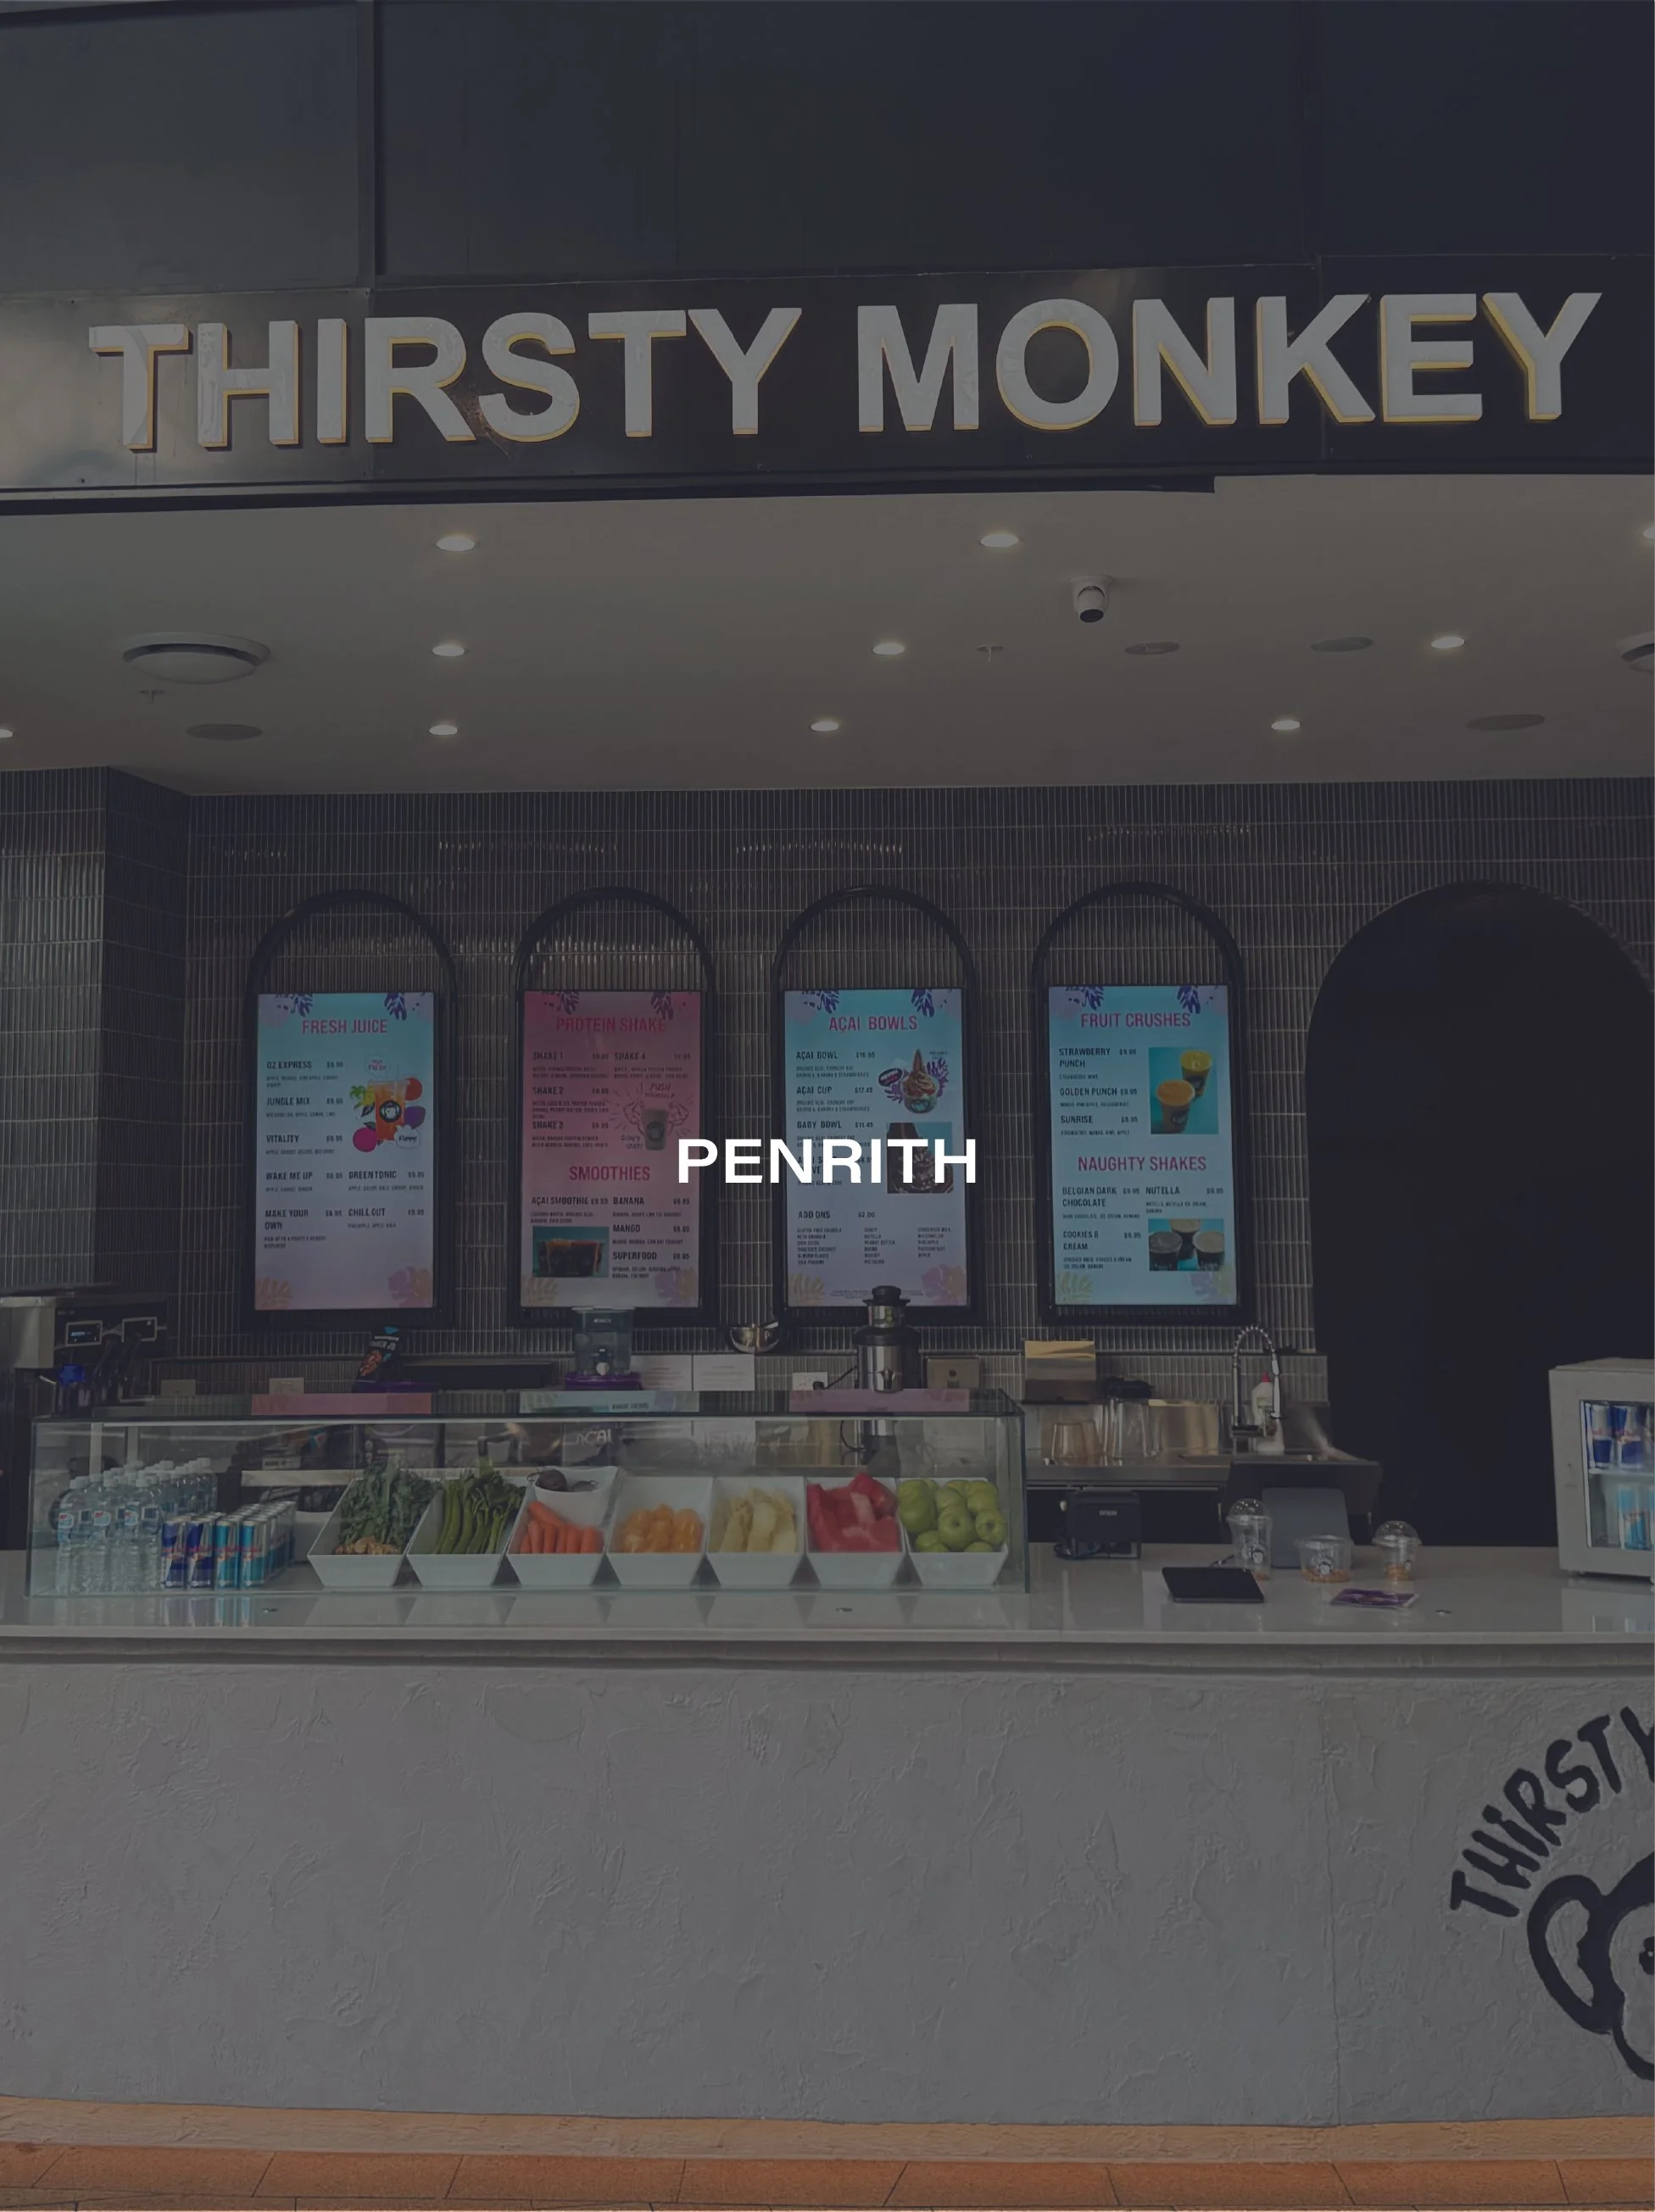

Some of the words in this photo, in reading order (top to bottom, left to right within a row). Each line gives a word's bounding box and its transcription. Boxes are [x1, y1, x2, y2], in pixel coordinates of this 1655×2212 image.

[88, 306, 802, 452] THIRSTY
[857, 291, 1602, 433] MONKEY
[829, 1017, 861, 1033] AÇAI
[868, 1016, 917, 1030] BOWLS
[1080, 1013, 1120, 1028] FRUIT
[1125, 1012, 1190, 1027] CRUSHES
[302, 1019, 347, 1034] FRESH
[351, 1019, 387, 1034] JUICE
[556, 1017, 616, 1033] PROTEIN
[620, 1017, 666, 1032] SHAKE
[533, 1052, 557, 1061] SHAKE
[615, 1052, 638, 1061] SHAKE
[1060, 1060, 1085, 1068] PUNCH
[650, 1083, 671, 1091] PUSH
[1060, 1088, 1089, 1096] GOLDEN
[1091, 1088, 1117, 1096] PUNCH
[267, 1097, 293, 1106] JUNGLE
[296, 1097, 310, 1106] MIX
[266, 1134, 299, 1143] VITALITY
[1078, 1156, 1145, 1172] NAUGHTY
[1150, 1156, 1207, 1171] SHAKES
[266, 1172, 287, 1180] WAKE
[289, 1172, 300, 1180] ME
[303, 1171, 313, 1180] UP
[348, 1171, 374, 1179] GREEN
[375, 1170, 397, 1178] TONIC
[569, 1166, 650, 1181] SMOOTHIES
[1062, 1187, 1095, 1195] BELGIAN
[1145, 1186, 1180, 1195] NUTELLA
[549, 1196, 588, 1205] SMOOTHIE
[1062, 1199, 1106, 1207] CHOCOLATE
[289, 1209, 309, 1217] YOUR
[348, 1208, 370, 1217] CHILL
[371, 1207, 386, 1217] OUT
[798, 1211, 814, 1219] ADD
[815, 1211, 831, 1219] ONS
[265, 1222, 282, 1230] OWN
[613, 1224, 641, 1233] MANGO
[1063, 1230, 1093, 1239] COOKIES
[613, 1251, 657, 1260] SUPERFOOD
